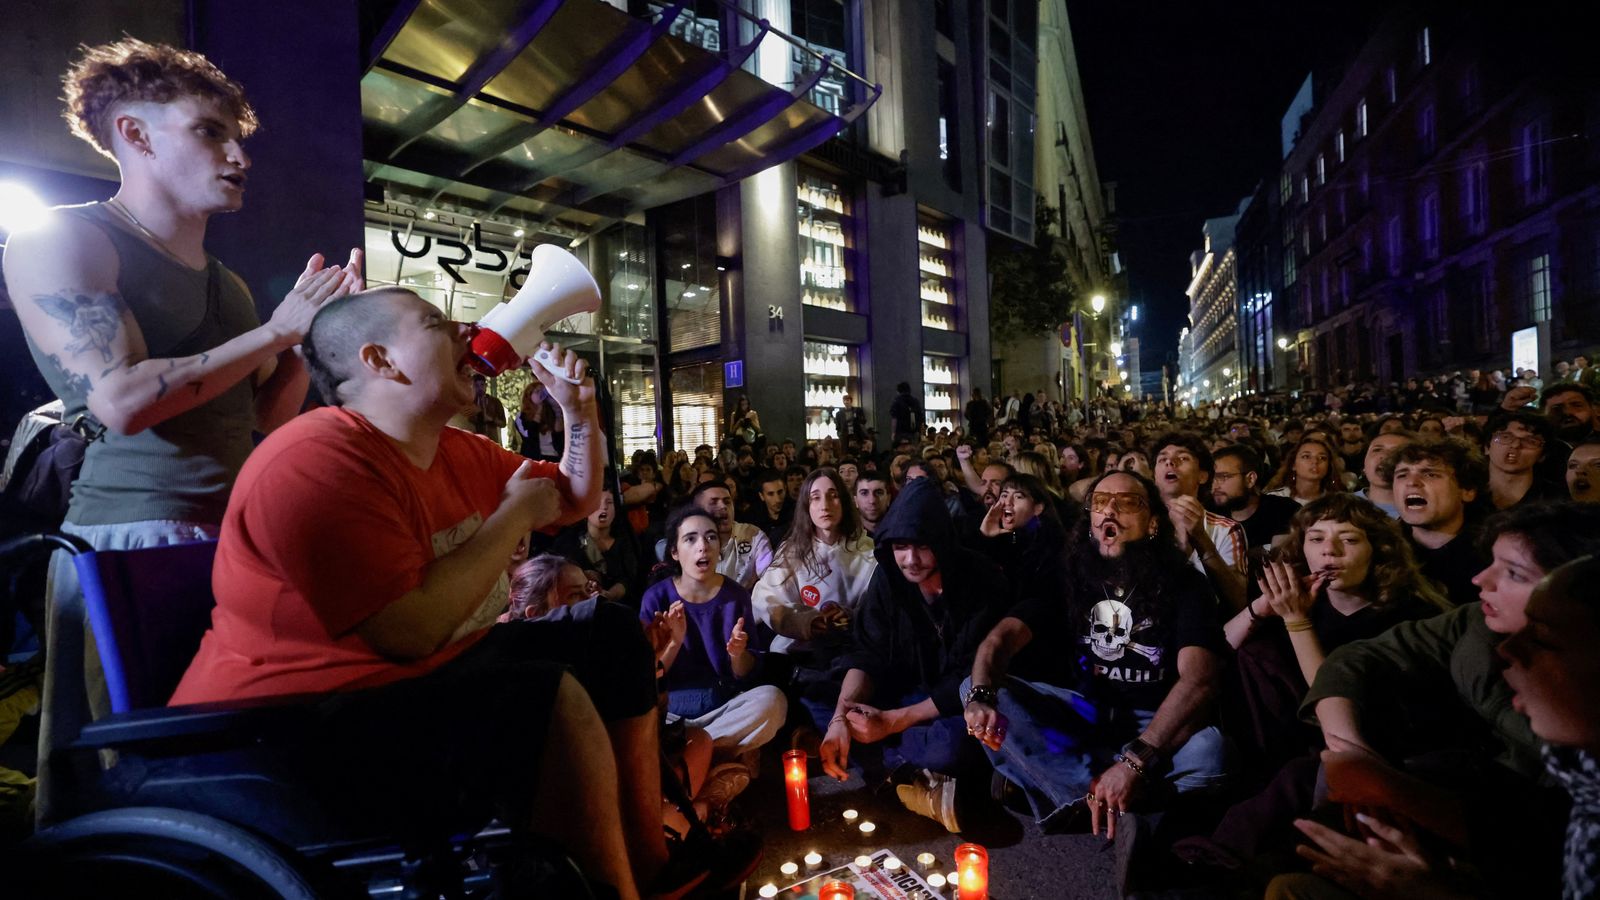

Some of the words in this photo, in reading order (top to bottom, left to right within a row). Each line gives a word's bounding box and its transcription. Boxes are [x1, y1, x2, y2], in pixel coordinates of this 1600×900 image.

[386, 204, 457, 226] HOEL
[768, 305, 784, 320] 34
[803, 589, 819, 601] CRT
